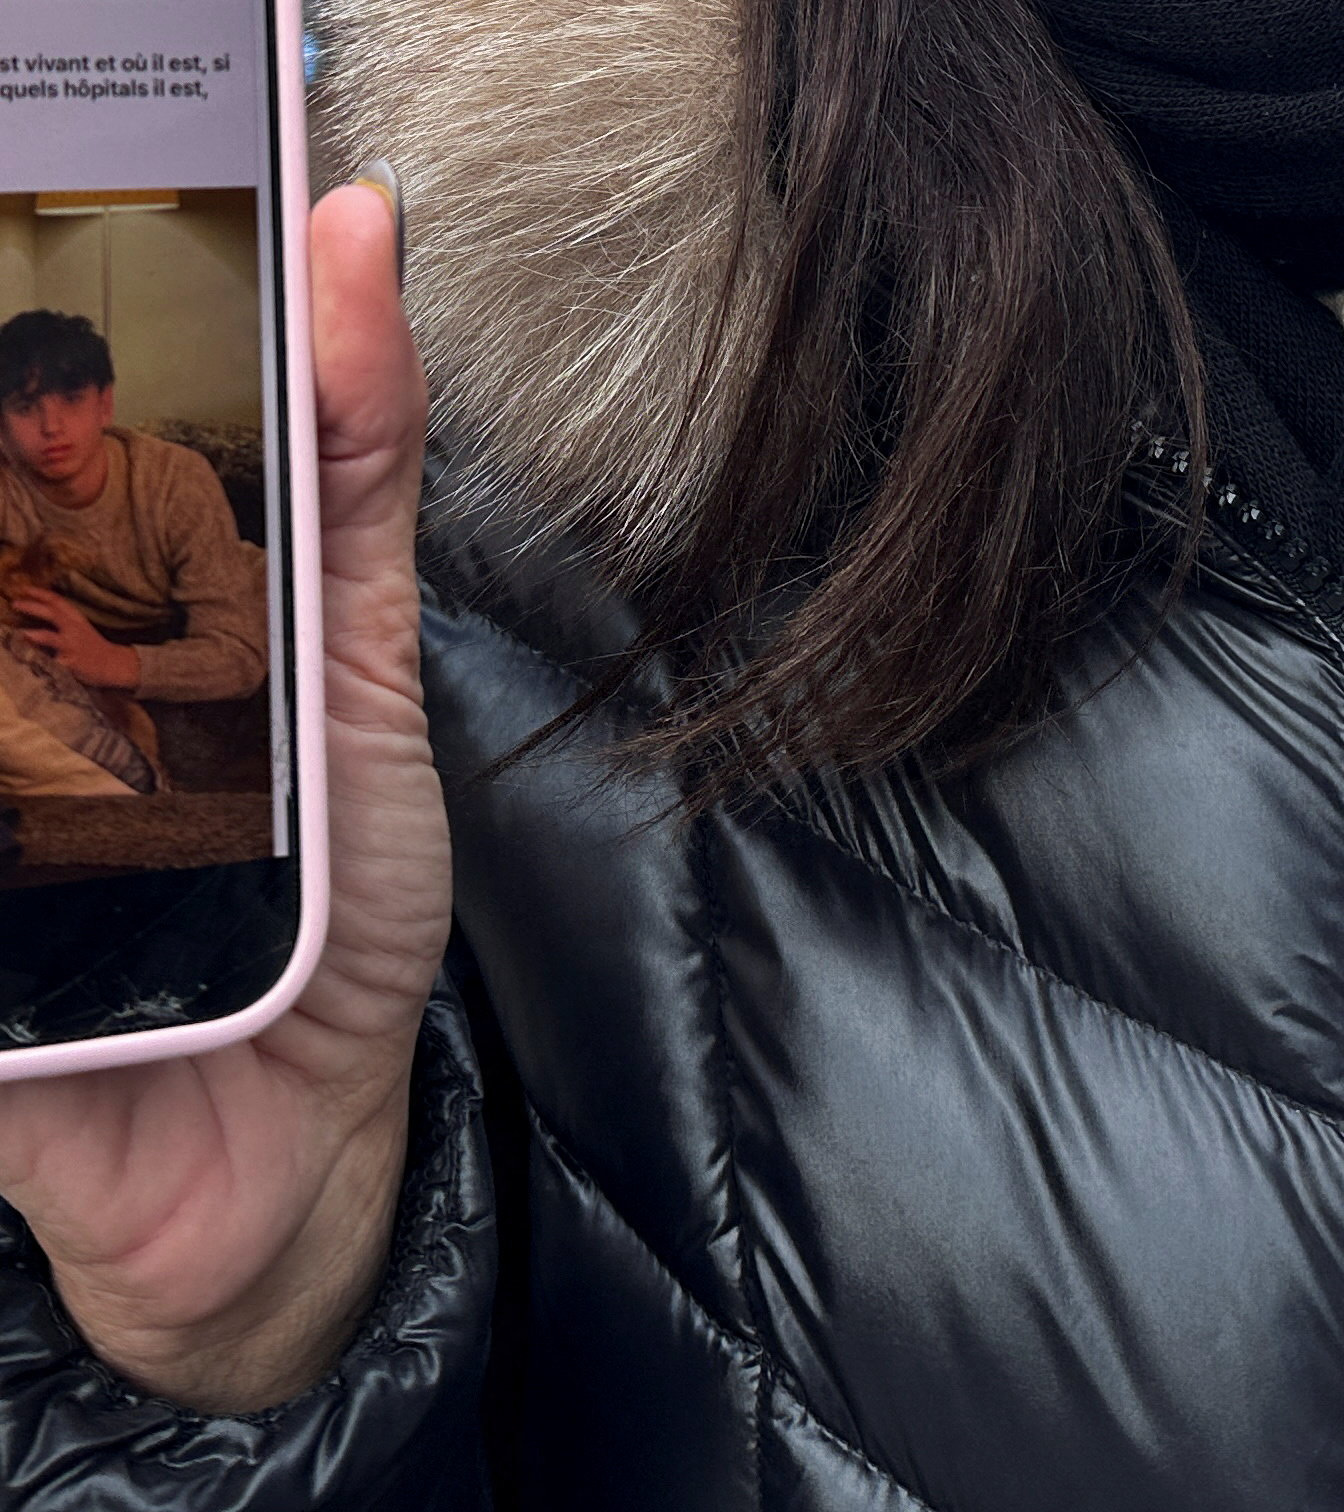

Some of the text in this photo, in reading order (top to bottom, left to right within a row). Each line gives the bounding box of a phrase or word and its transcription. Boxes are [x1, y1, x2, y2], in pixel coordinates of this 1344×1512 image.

[25, 53, 90, 73] vivant
[95, 56, 116, 73] et
[121, 53, 148, 73] où
[152, 53, 164, 72] il
[168, 55, 207, 74] est,
[212, 53, 230, 72] si
[0, 80, 58, 102] quels
[63, 78, 149, 102] hôpitals
[152, 79, 165, 97] il
[169, 80, 208, 100] est,
